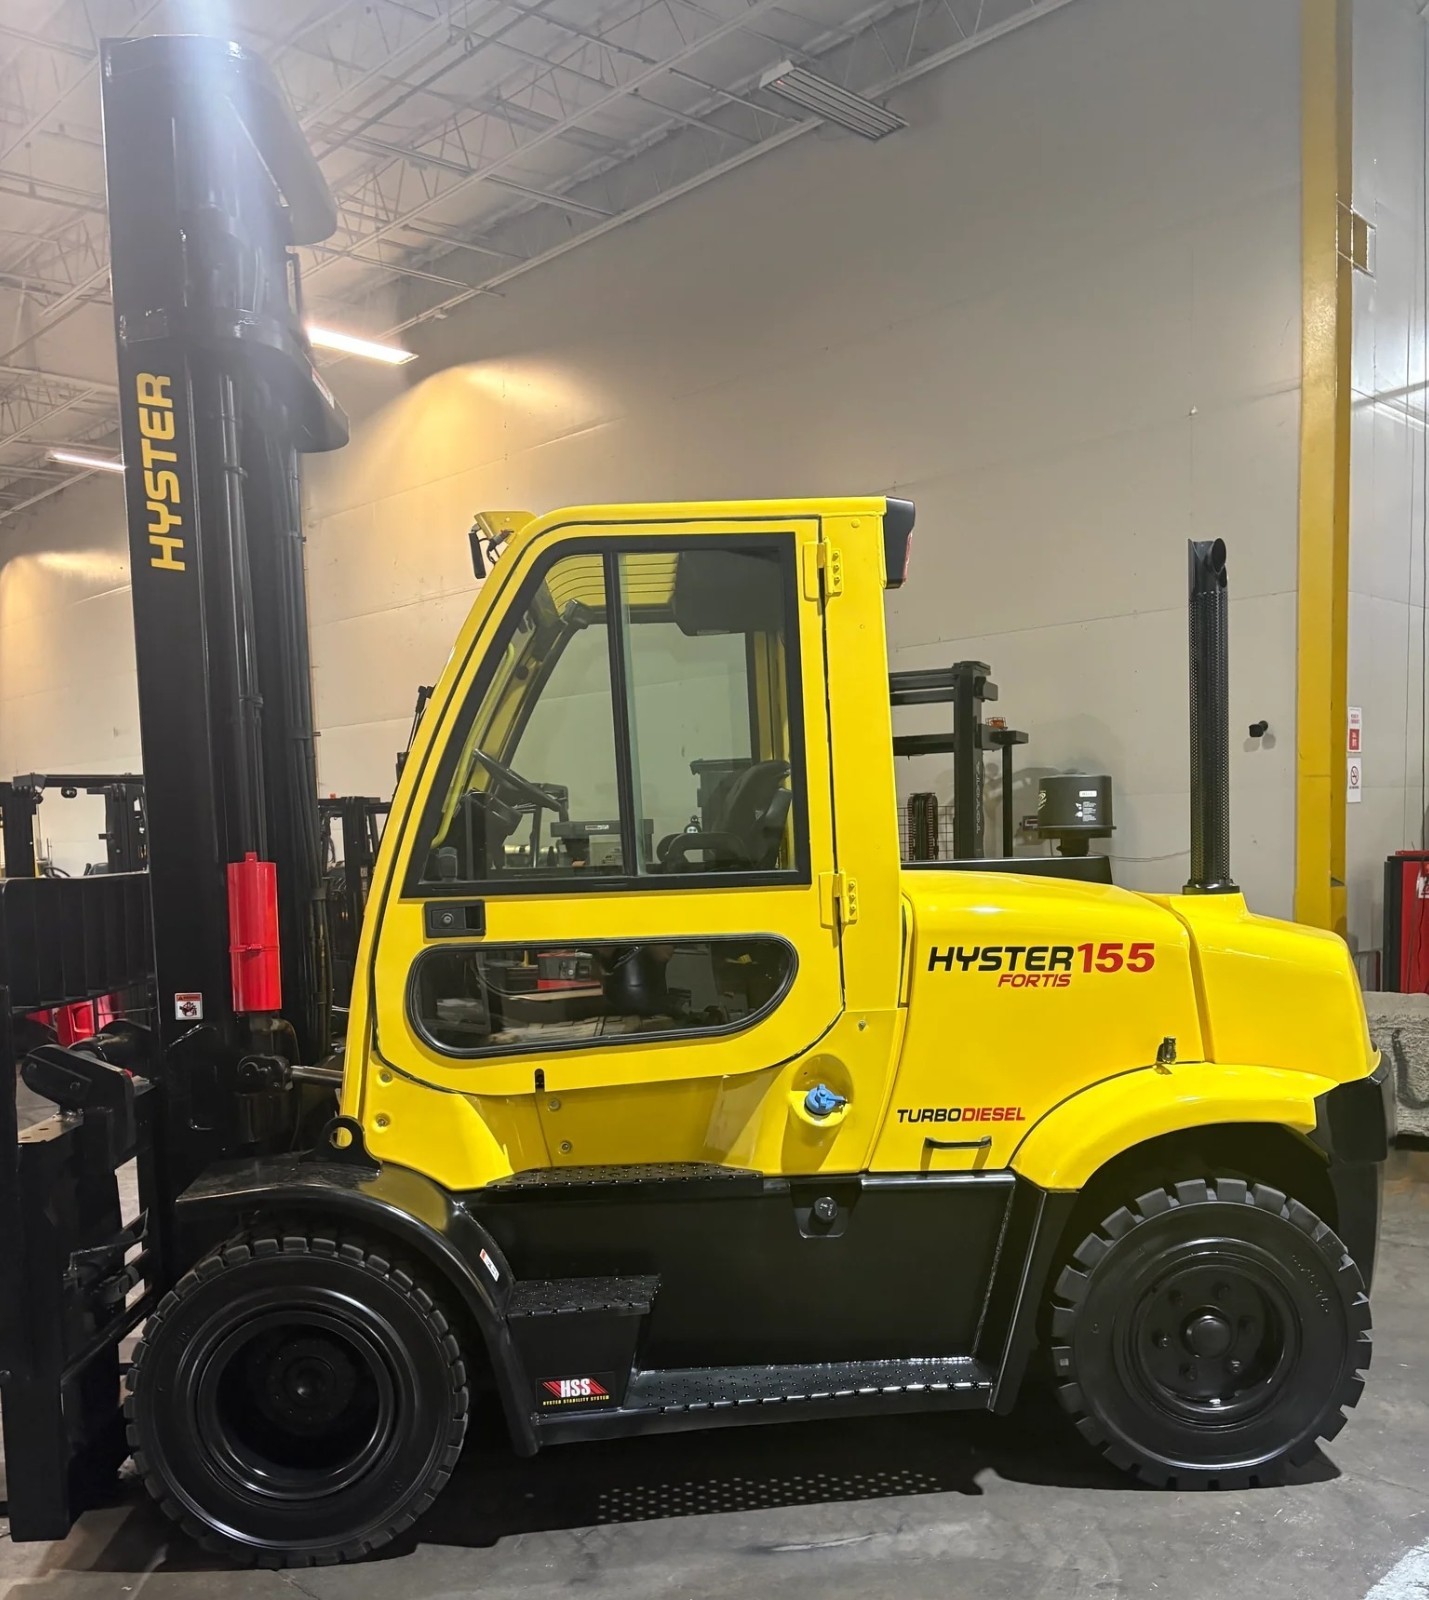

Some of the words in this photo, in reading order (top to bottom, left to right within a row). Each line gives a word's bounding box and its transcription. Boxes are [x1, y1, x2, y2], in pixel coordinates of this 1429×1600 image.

[136, 372, 186, 572] HYSTER
[927, 946, 1075, 972] HYSTER
[1077, 943, 1155, 973] 155
[997, 973, 1072, 988] FORTIS
[897, 1107, 1026, 1123] TURBODIESEL
[560, 1378, 591, 1398] HSS
